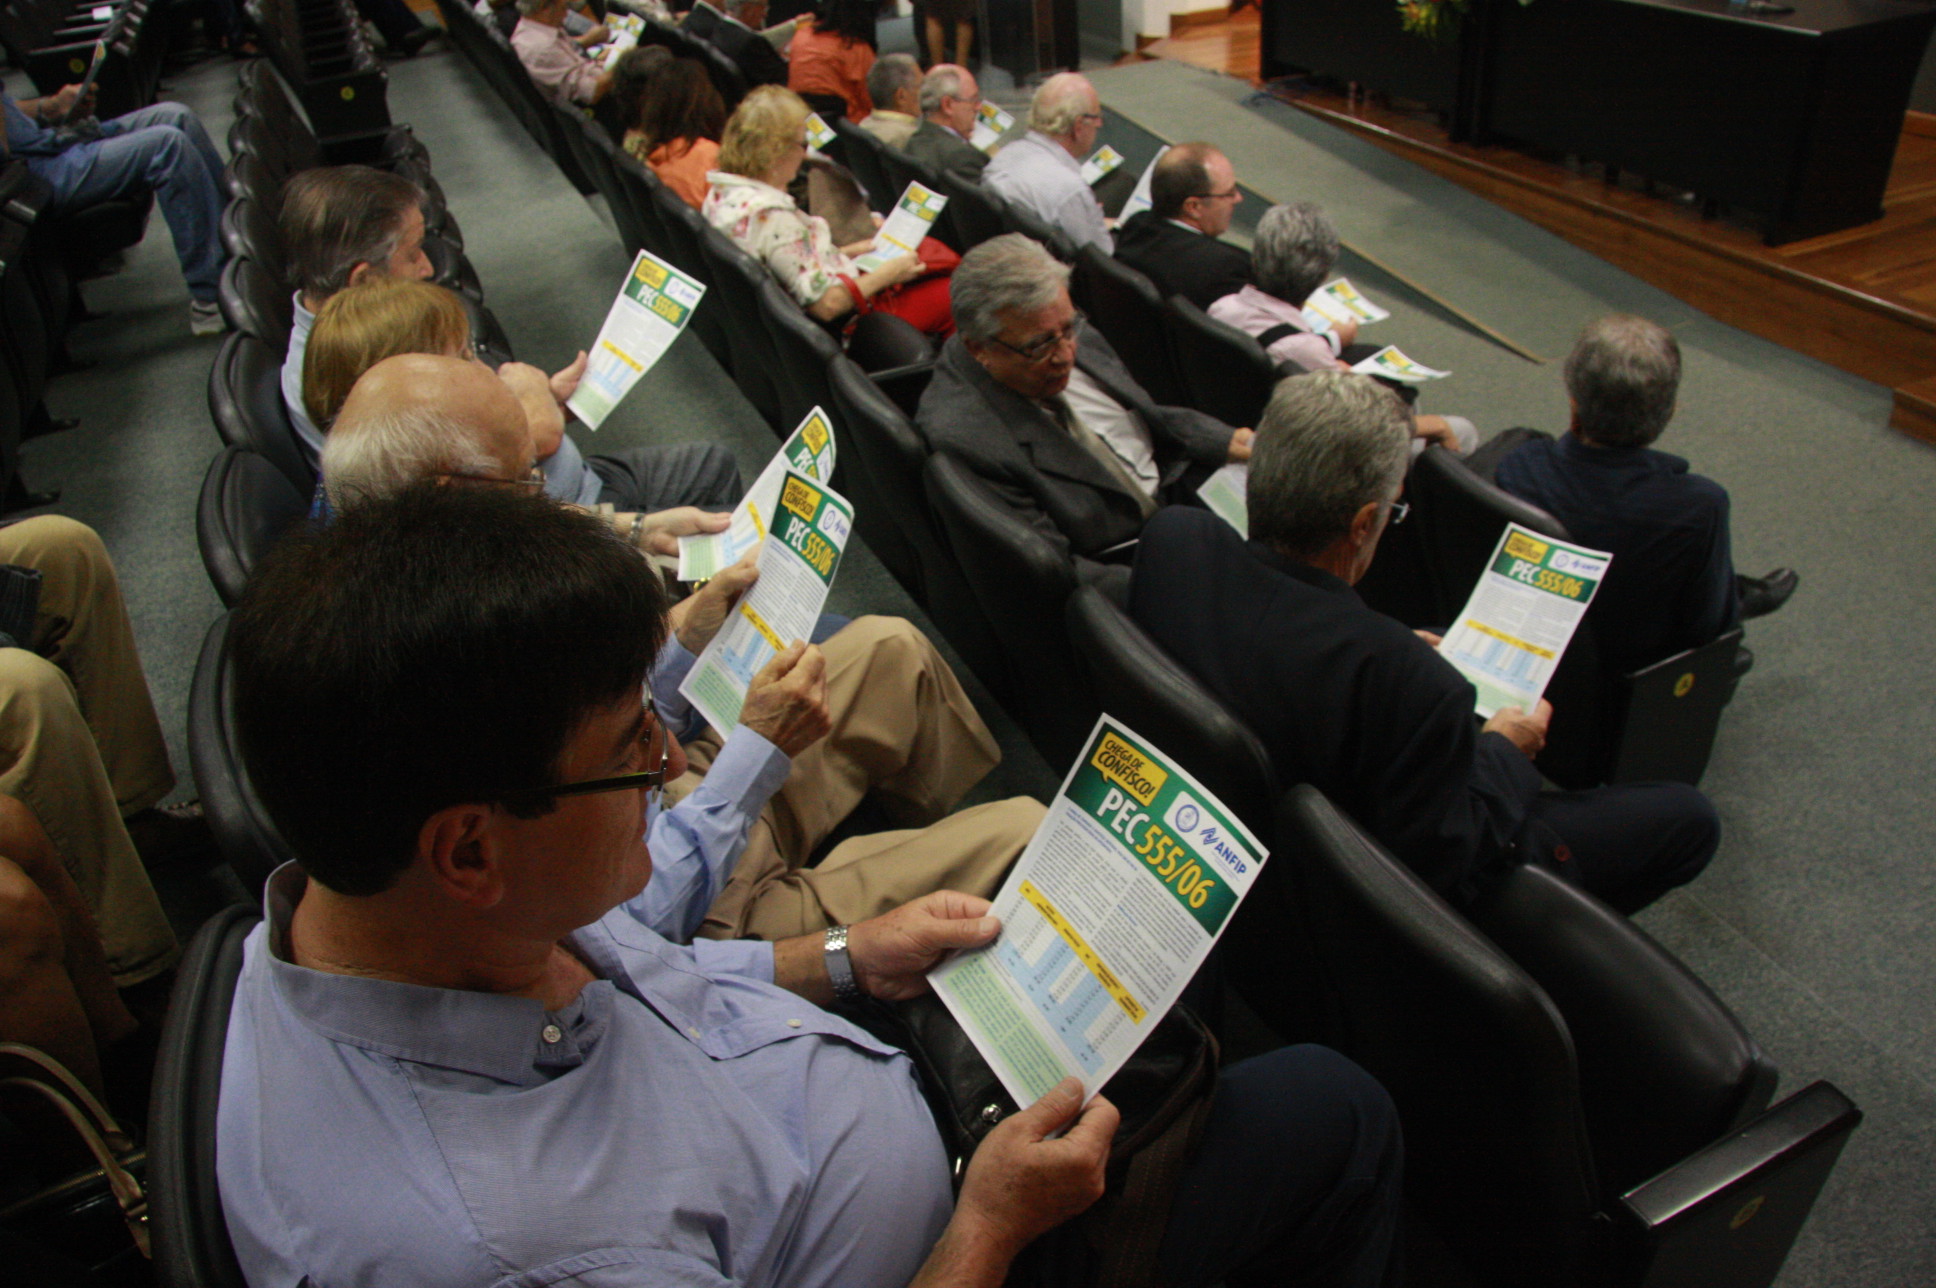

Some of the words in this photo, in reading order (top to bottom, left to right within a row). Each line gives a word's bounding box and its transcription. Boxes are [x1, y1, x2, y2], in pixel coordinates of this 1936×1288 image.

[784, 516, 811, 552] PEC
[801, 532, 836, 576] 555/06
[1508, 559, 1541, 584] PEC
[1534, 569, 1585, 598] 555/06
[1098, 751, 1156, 798] CONFISCO!
[1105, 740, 1133, 763] CHEGA
[1130, 758, 1145, 771] DE
[1096, 787, 1150, 845] PEC
[1134, 824, 1216, 909] 555/06
[1214, 841, 1247, 874] ANFIP
